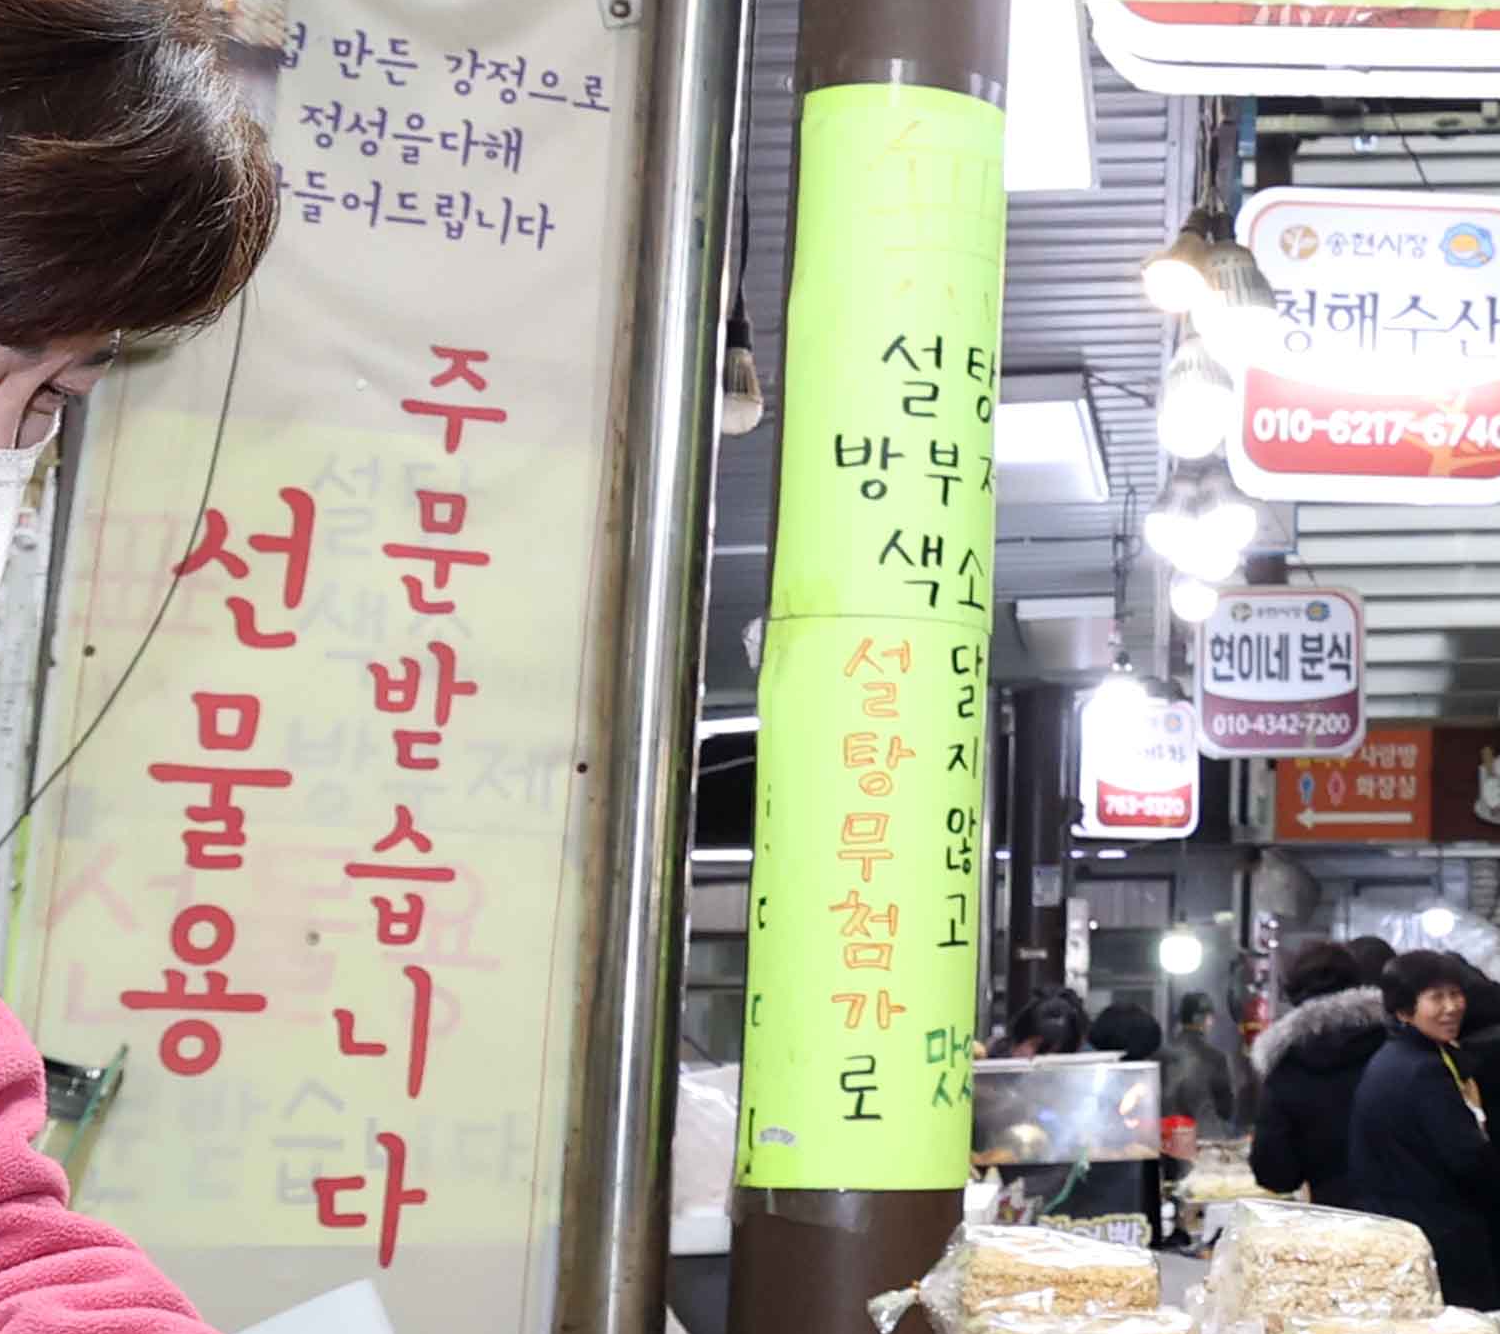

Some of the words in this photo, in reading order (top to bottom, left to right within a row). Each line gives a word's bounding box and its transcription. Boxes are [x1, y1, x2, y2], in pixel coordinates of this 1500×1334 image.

[331, 30, 419, 87] 만든
[443, 48, 612, 113] 강정으로
[277, 161, 556, 250] 들어드립니다
[1323, 226, 1428, 260] 송현시장
[1210, 633, 1291, 683] 현이네
[1299, 632, 1354, 683] 분식
[1212, 712, 1351, 738] 010-4342-7200
[119, 486, 316, 1077] 선물용
